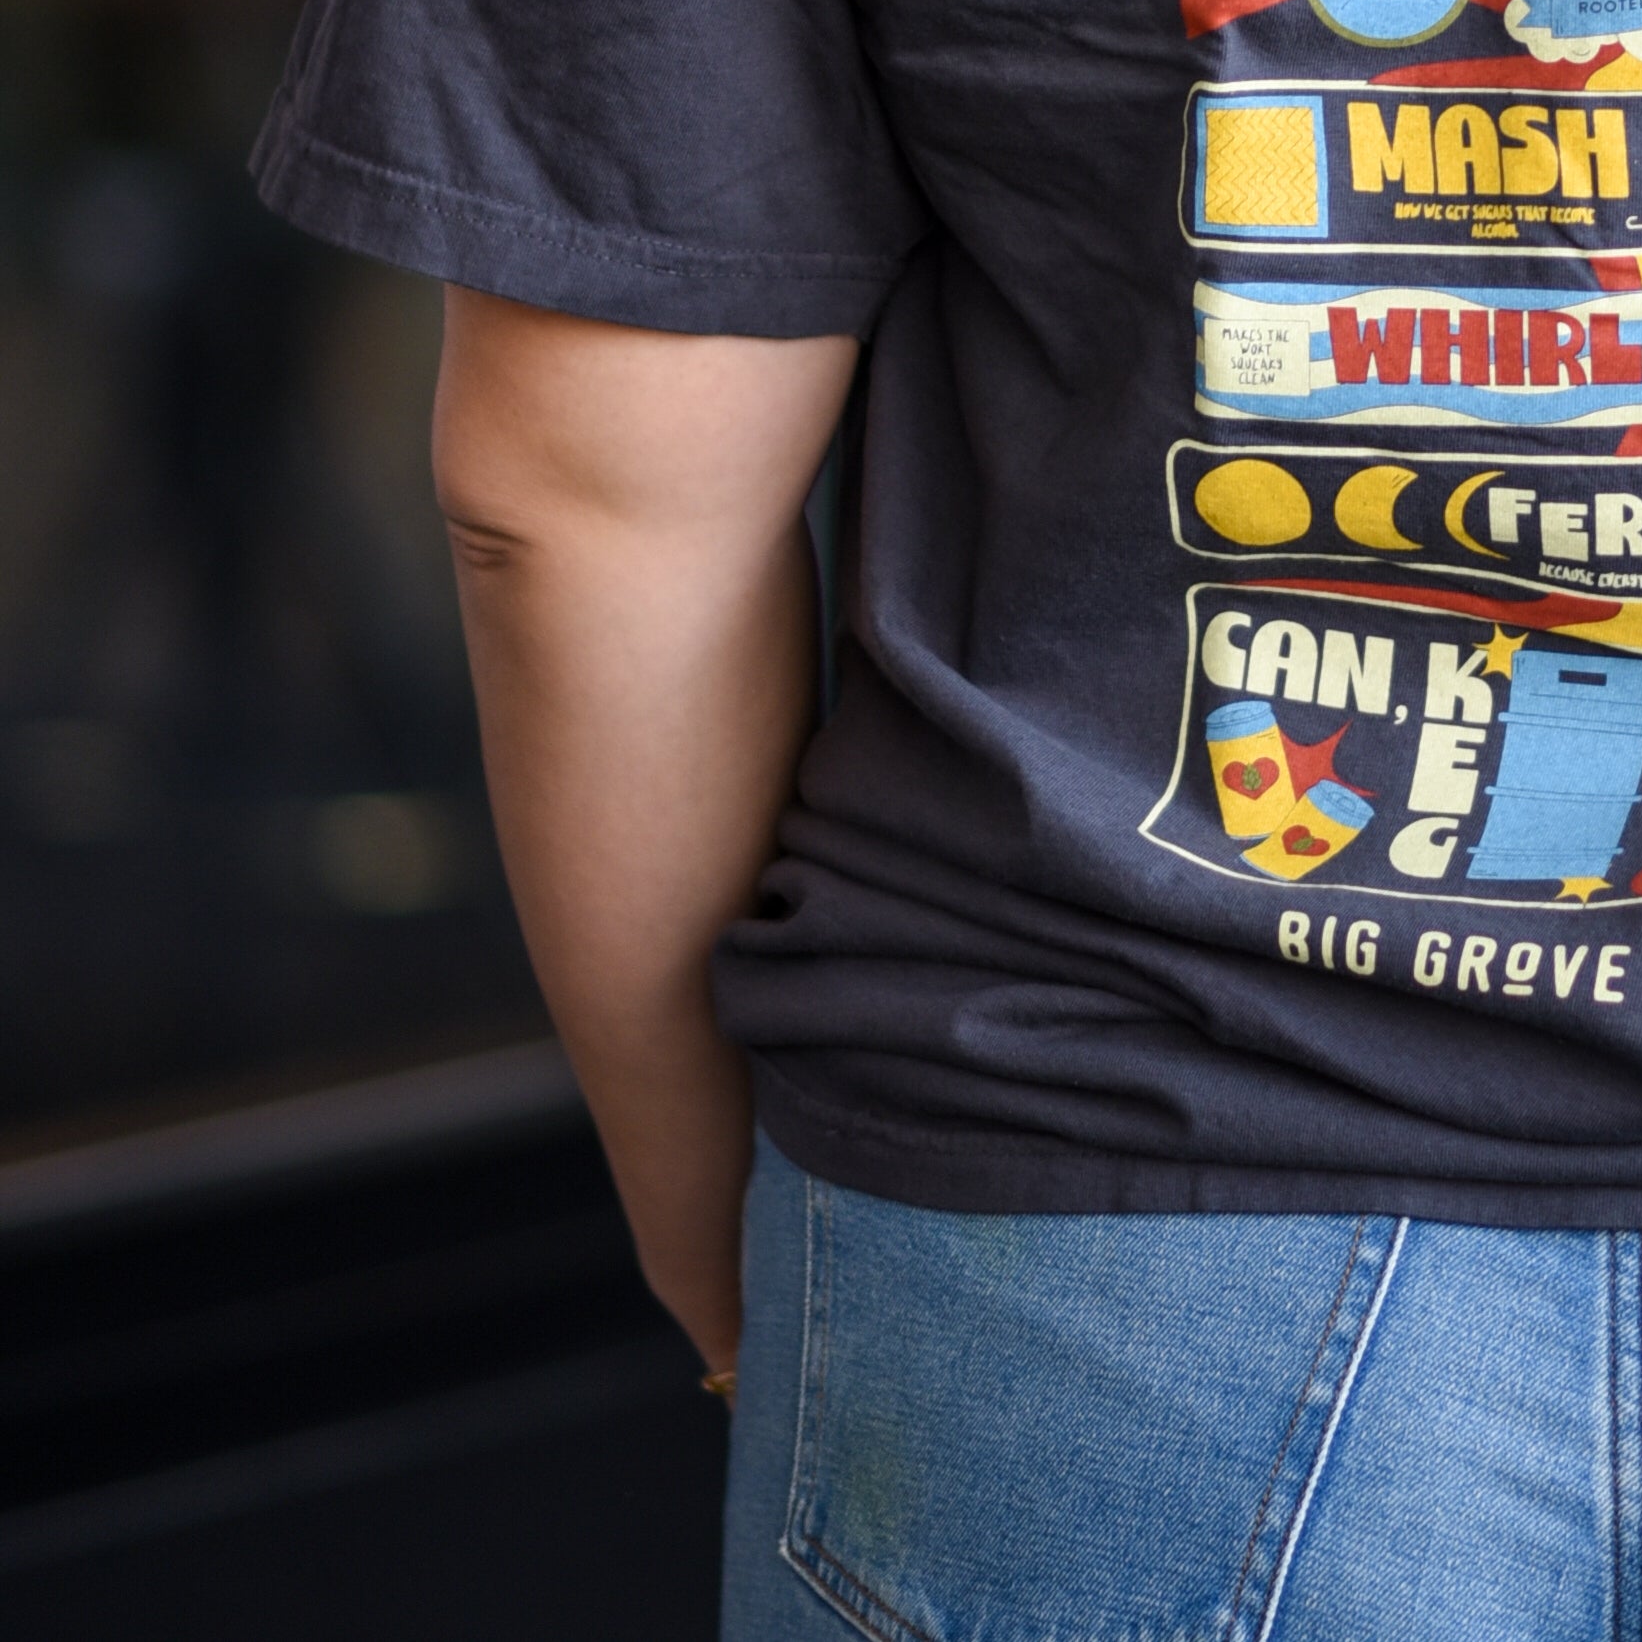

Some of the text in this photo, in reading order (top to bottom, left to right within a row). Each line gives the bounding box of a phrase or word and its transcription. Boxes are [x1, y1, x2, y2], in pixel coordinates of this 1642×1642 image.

[1347, 101, 1629, 199] MASH
[1394, 202, 1421, 219] HOW
[1423, 203, 1443, 220] WE
[1445, 205, 1470, 221] GET
[1472, 204, 1513, 221] SUGARS
[1515, 205, 1548, 222] THAT
[1222, 328, 1289, 342] MAKES THE
[1240, 343, 1272, 356] WORT
[1327, 307, 1642, 386] WHIRL
[1231, 357, 1283, 370] SQUEAKY
[1239, 372, 1275, 385] CLEAN
[1539, 561, 1594, 586] BECAUSE
[1202, 610, 1408, 725] CAN,
[1389, 641, 1493, 879] KEG
[1278, 910, 1380, 975] BIG
[1413, 931, 1631, 1003] GROVE
